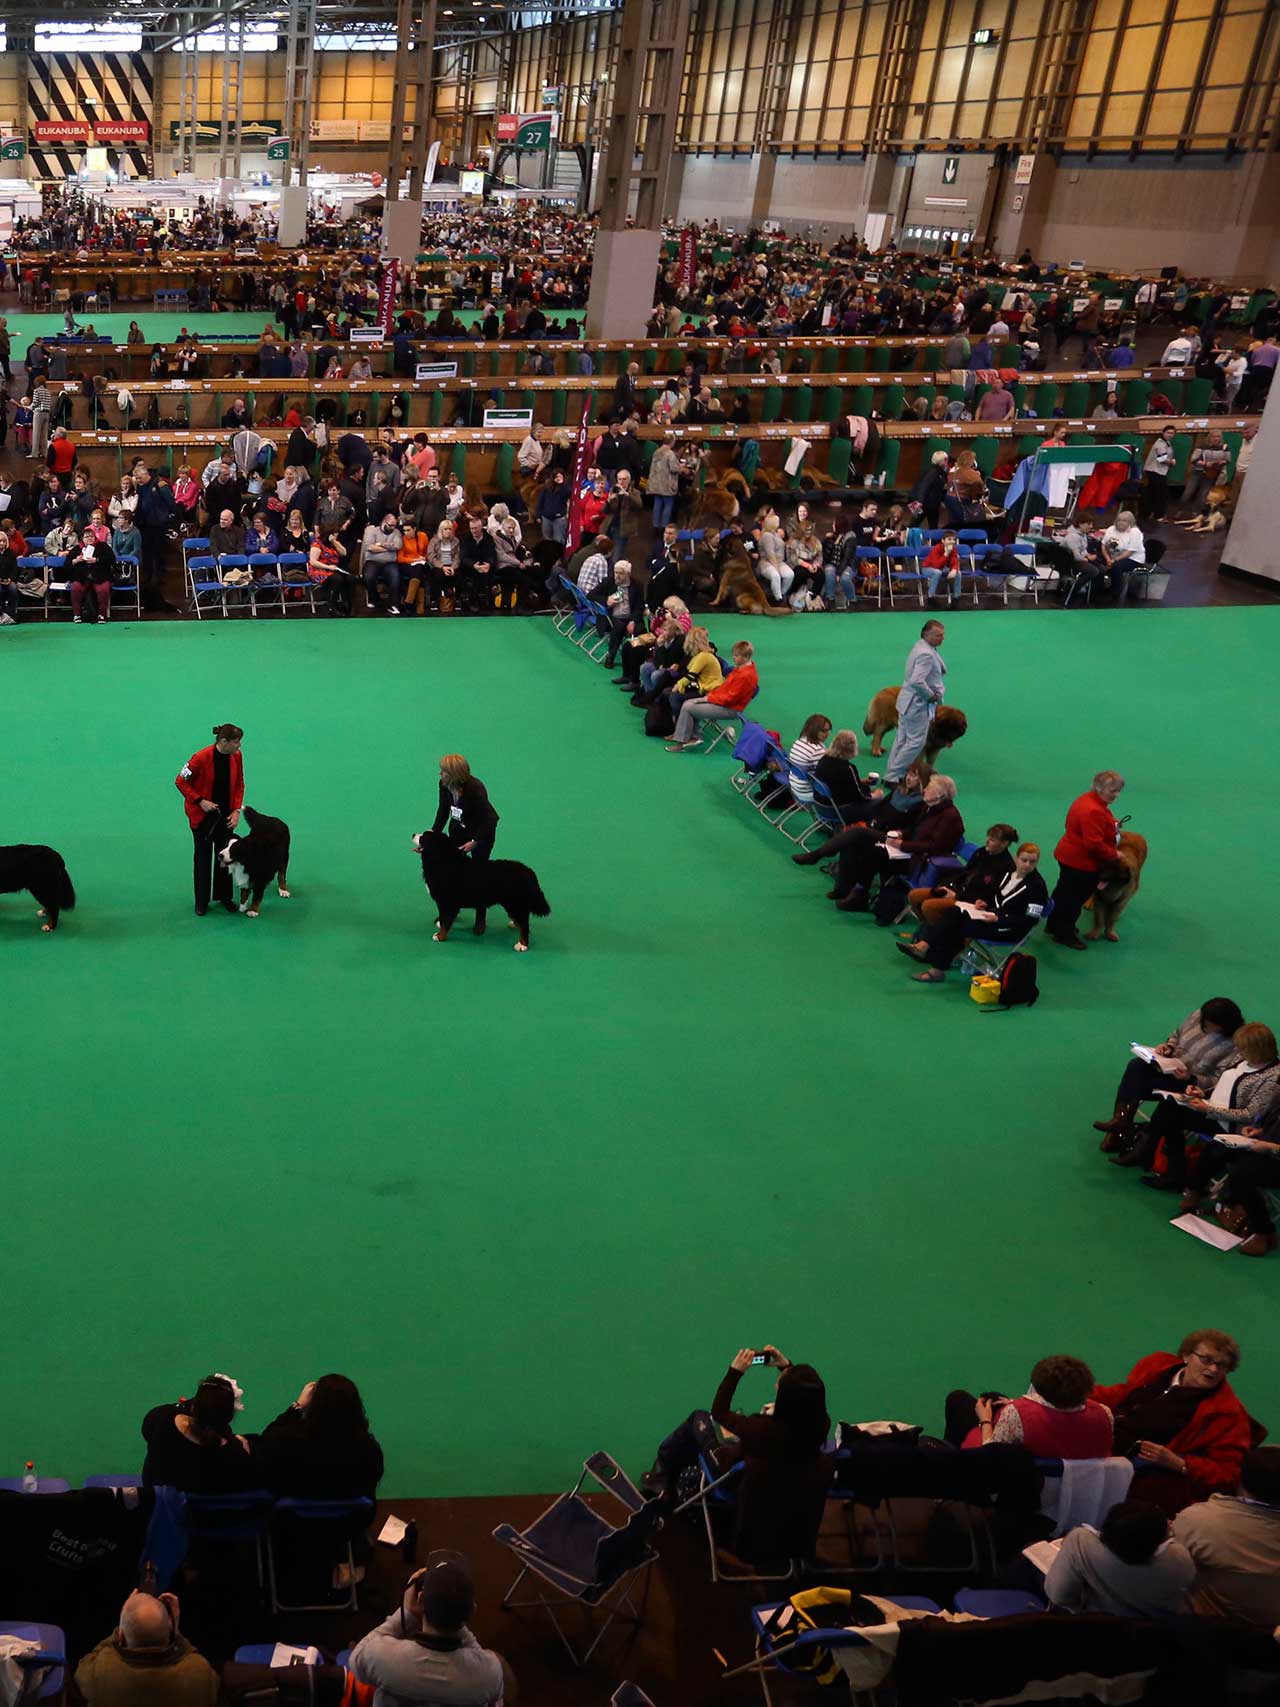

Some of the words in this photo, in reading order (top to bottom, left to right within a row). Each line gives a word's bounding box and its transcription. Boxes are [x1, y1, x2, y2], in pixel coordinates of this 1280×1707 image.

[37, 126, 86, 136] EUKANUBA
[96, 126, 144, 136] EUKANUBA
[525, 132, 542, 144] 27
[8, 149, 19, 157] 26
[273, 148, 284, 157] 25
